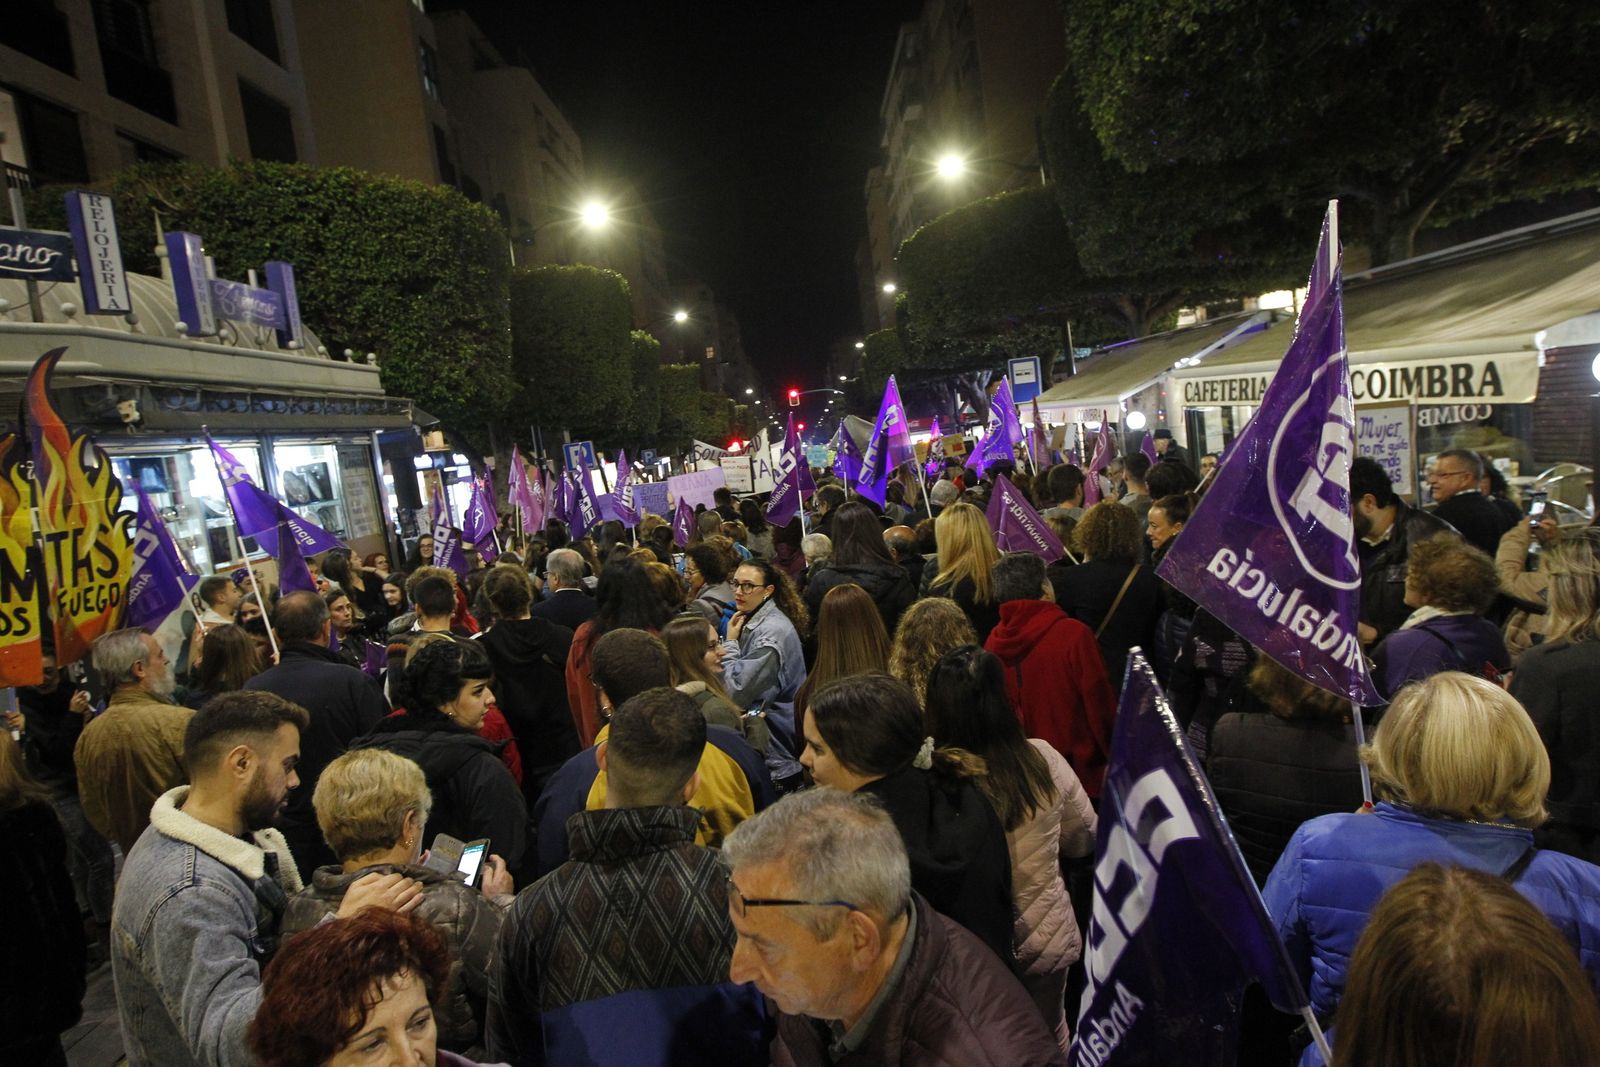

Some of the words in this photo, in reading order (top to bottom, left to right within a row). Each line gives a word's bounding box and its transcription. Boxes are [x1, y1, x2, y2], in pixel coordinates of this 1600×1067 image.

[89, 195, 120, 309] RELOJERIA
[1184, 375, 1267, 403] CAFETERIA
[1351, 361, 1504, 400] COIMBRA
[644, 451, 654, 461] P
[57, 582, 121, 617] FUEGO
